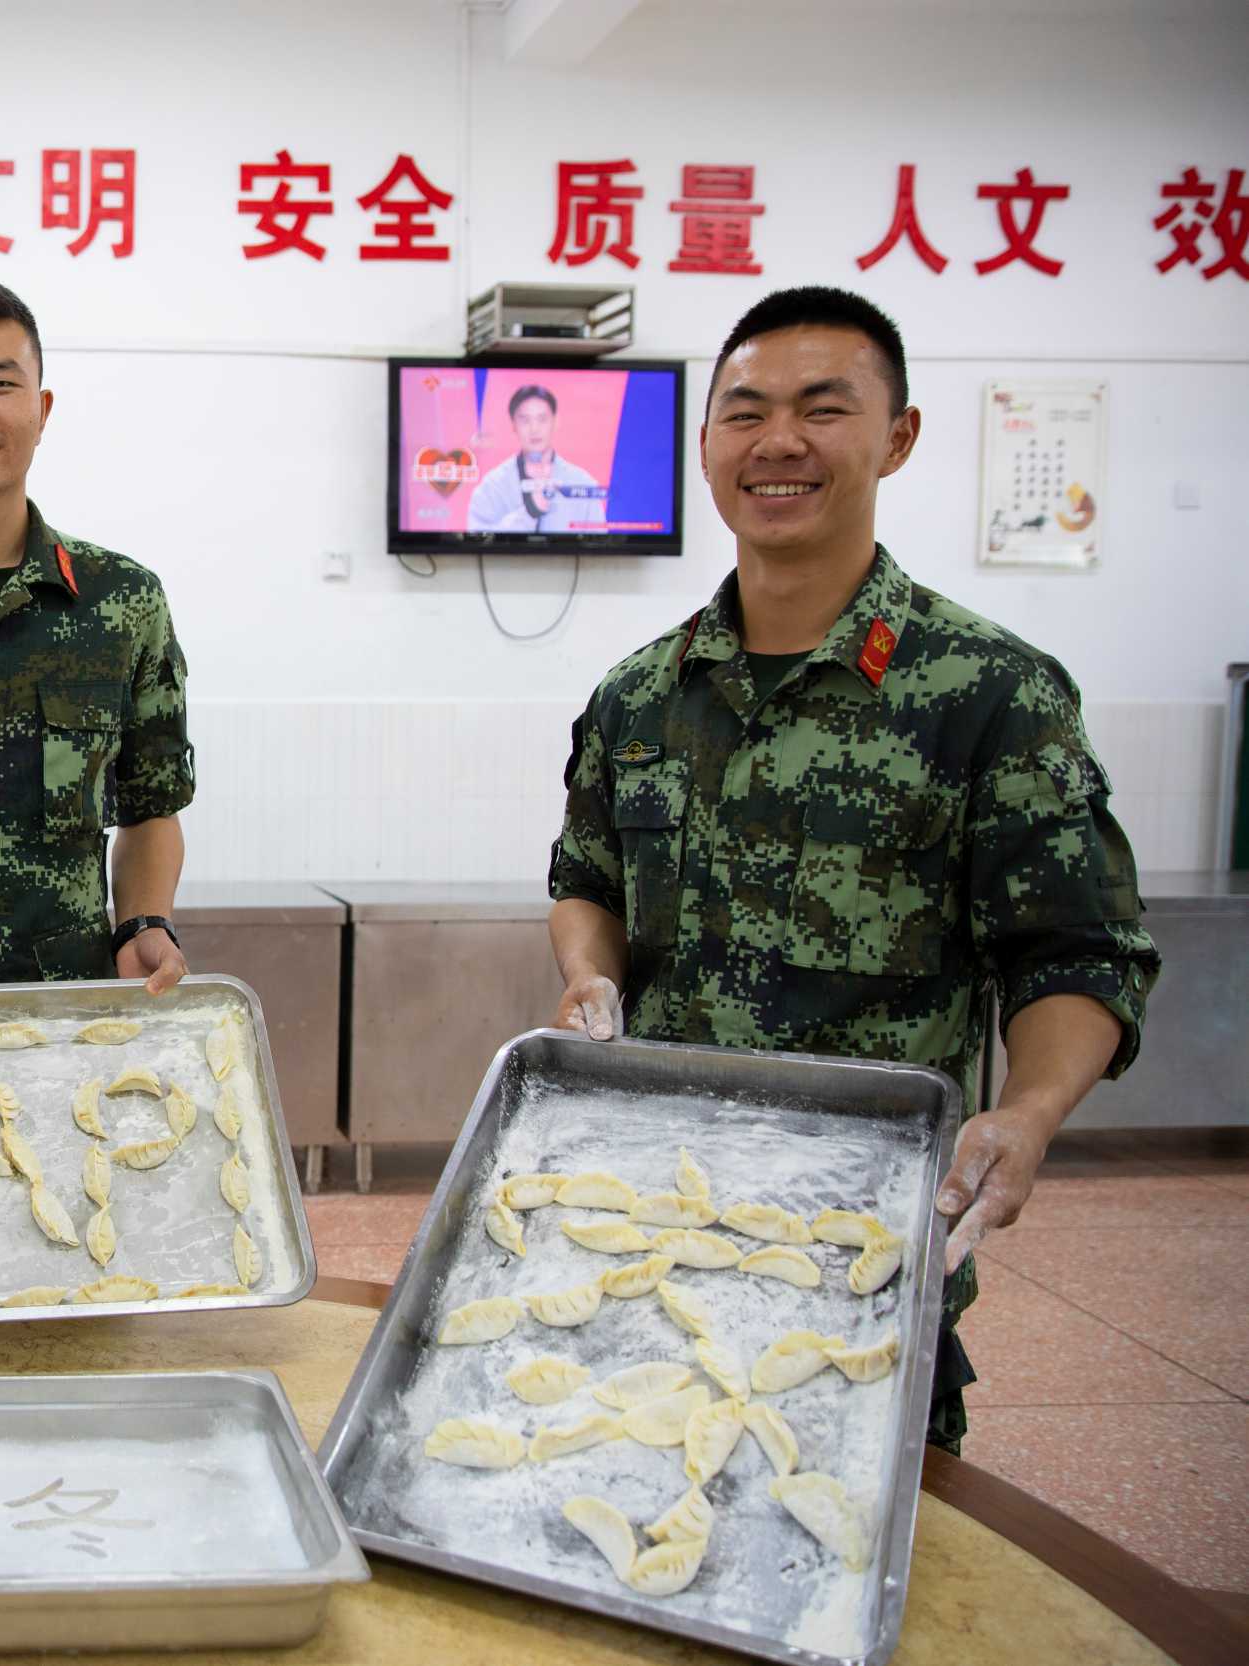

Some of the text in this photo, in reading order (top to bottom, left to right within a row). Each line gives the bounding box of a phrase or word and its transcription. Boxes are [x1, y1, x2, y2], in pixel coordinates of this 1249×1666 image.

[237, 149, 454, 262] 安全
[545, 158, 765, 276] 质量
[856, 163, 1070, 277] 人文
